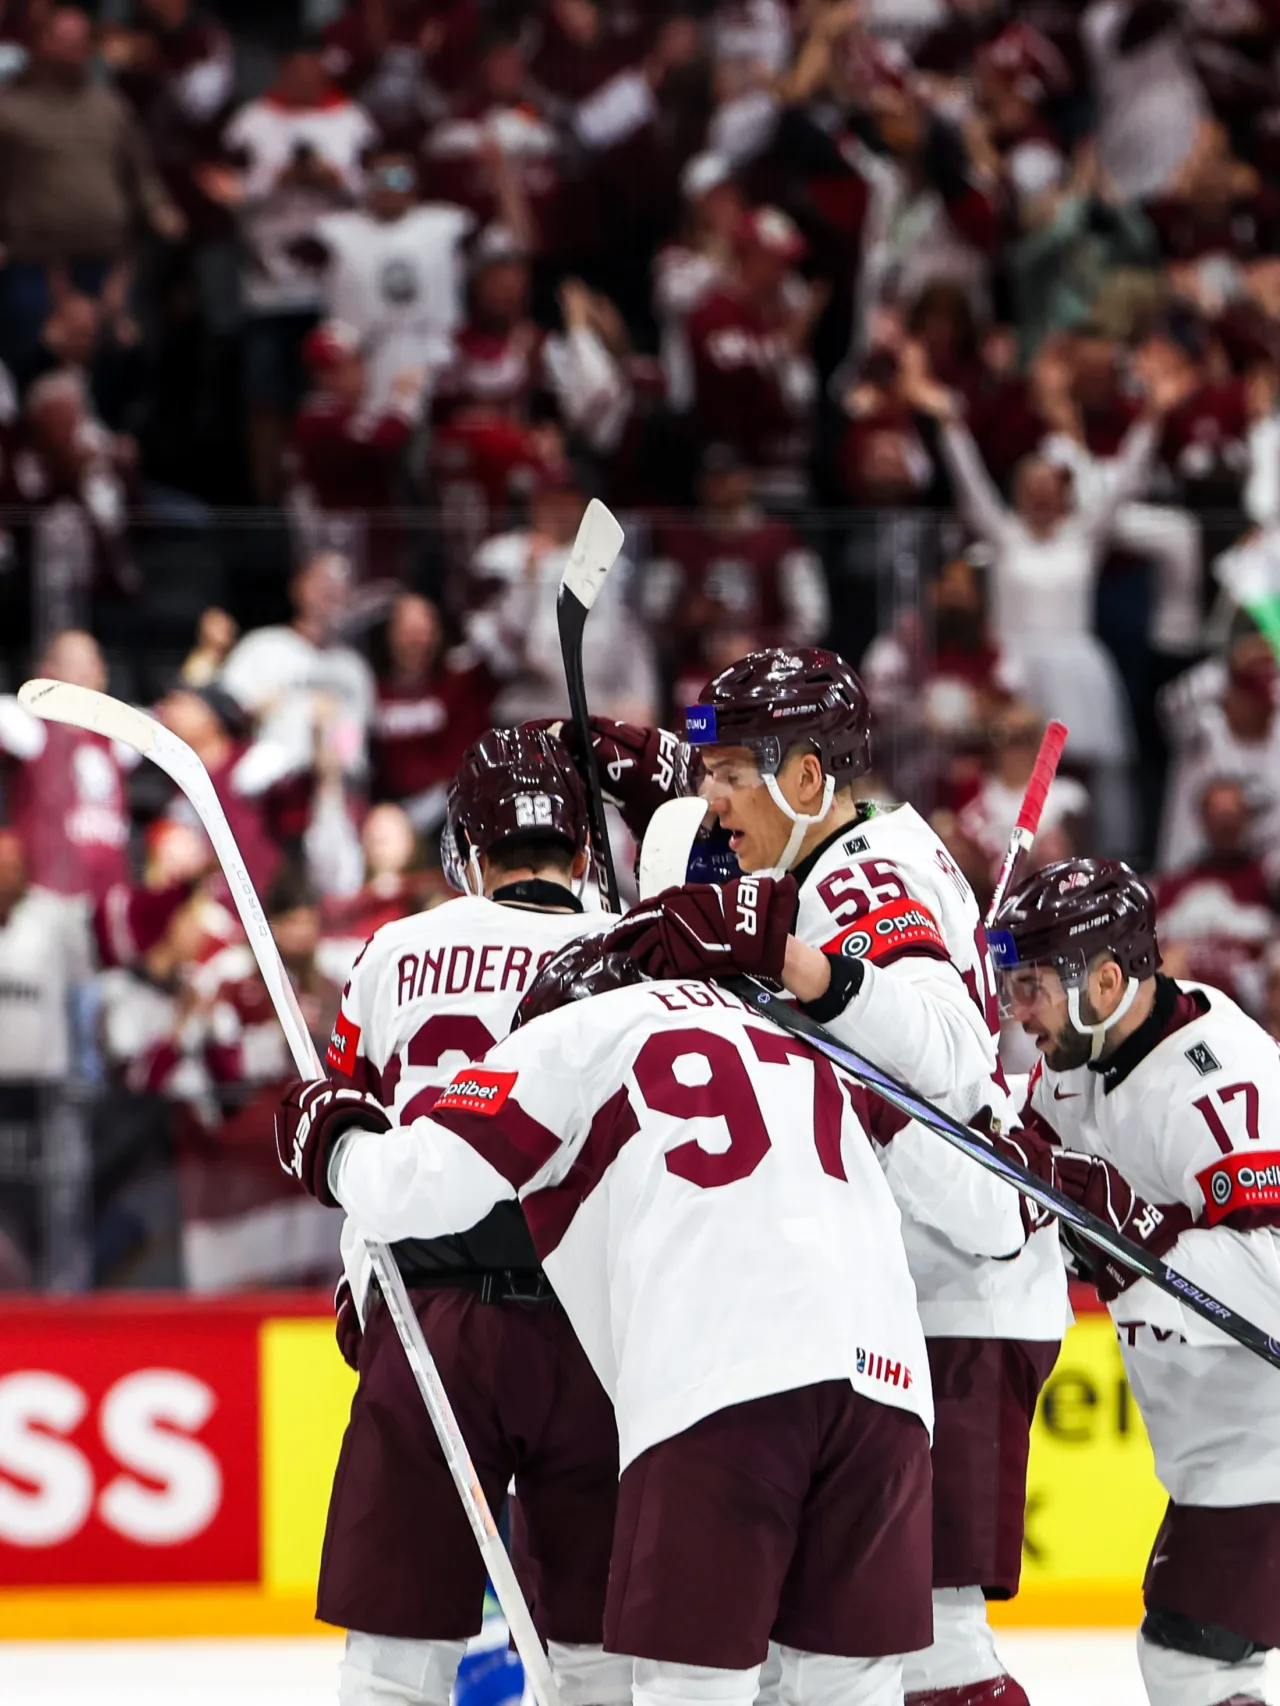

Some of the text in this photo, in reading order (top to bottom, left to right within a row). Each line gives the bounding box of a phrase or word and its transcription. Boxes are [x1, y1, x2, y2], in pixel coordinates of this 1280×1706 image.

[515, 794, 553, 827] 22
[816, 859, 909, 928] 55
[1069, 913, 1110, 936] BAUER
[441, 1080, 499, 1100] ptibet
[632, 1024, 849, 1189] 97
[1192, 1080, 1260, 1155] 17
[1171, 1278, 1232, 1320] BAUER
